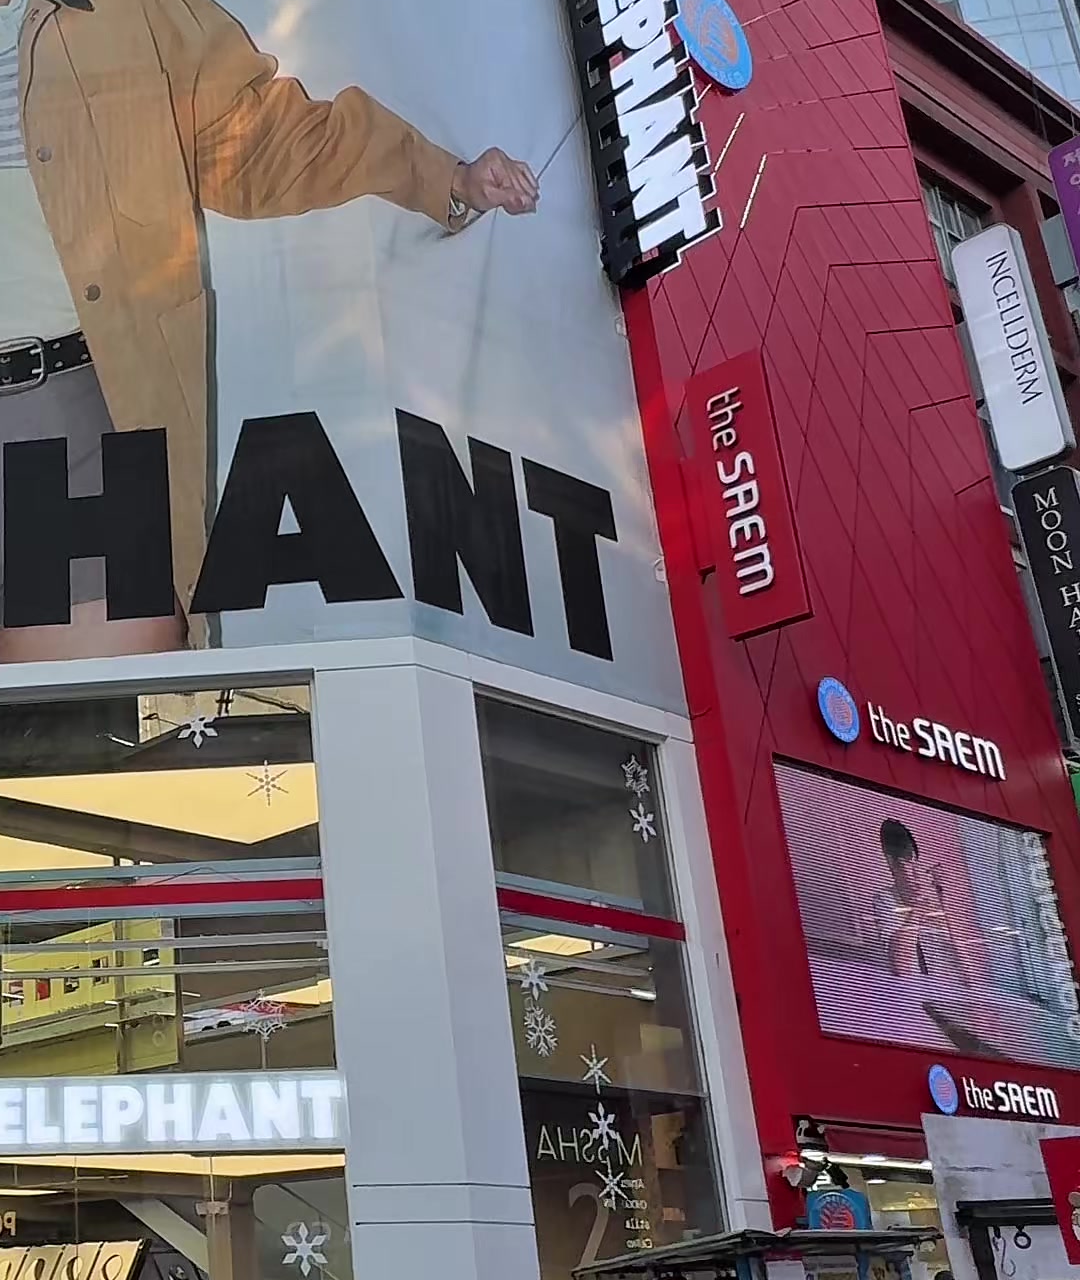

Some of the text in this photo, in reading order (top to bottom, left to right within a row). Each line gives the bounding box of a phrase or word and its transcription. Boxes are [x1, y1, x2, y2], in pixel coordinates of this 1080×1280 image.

[986, 250, 1043, 407] INCELLDERM
[706, 386, 742, 451] the
[1032, 486, 1073, 575] MOON
[868, 701, 912, 752] the
[962, 1076, 994, 1111] the
